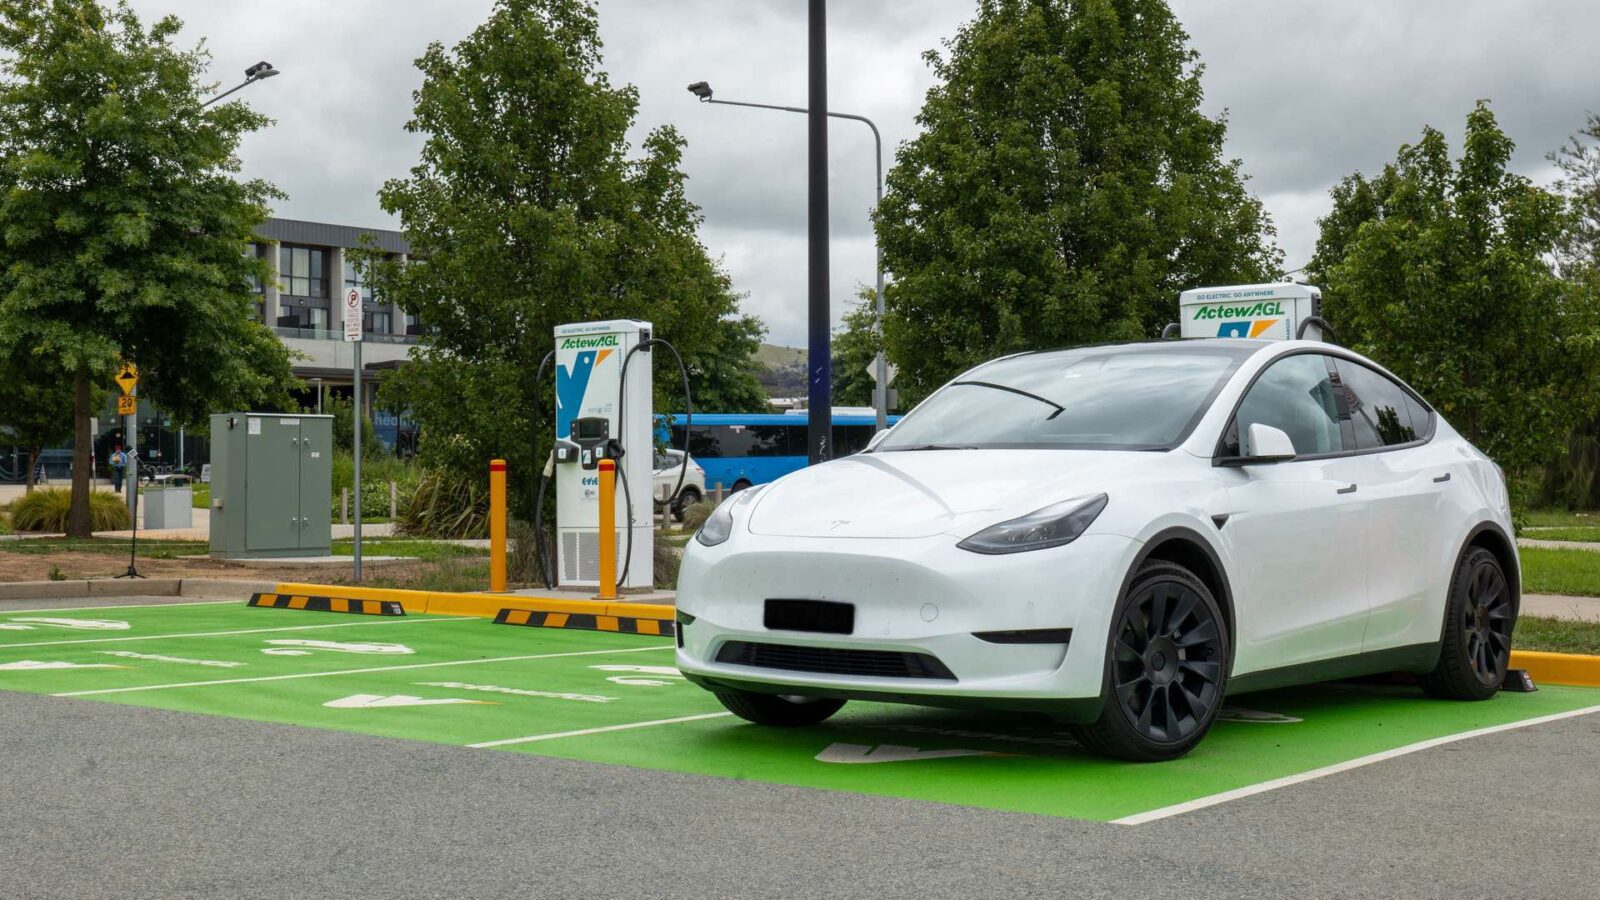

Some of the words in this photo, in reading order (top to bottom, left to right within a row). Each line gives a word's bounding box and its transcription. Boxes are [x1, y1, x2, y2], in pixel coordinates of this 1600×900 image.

[1193, 302, 1285, 320] ActewAGL
[561, 336, 619, 350] ActewAGL
[122, 398, 132, 408] 20
